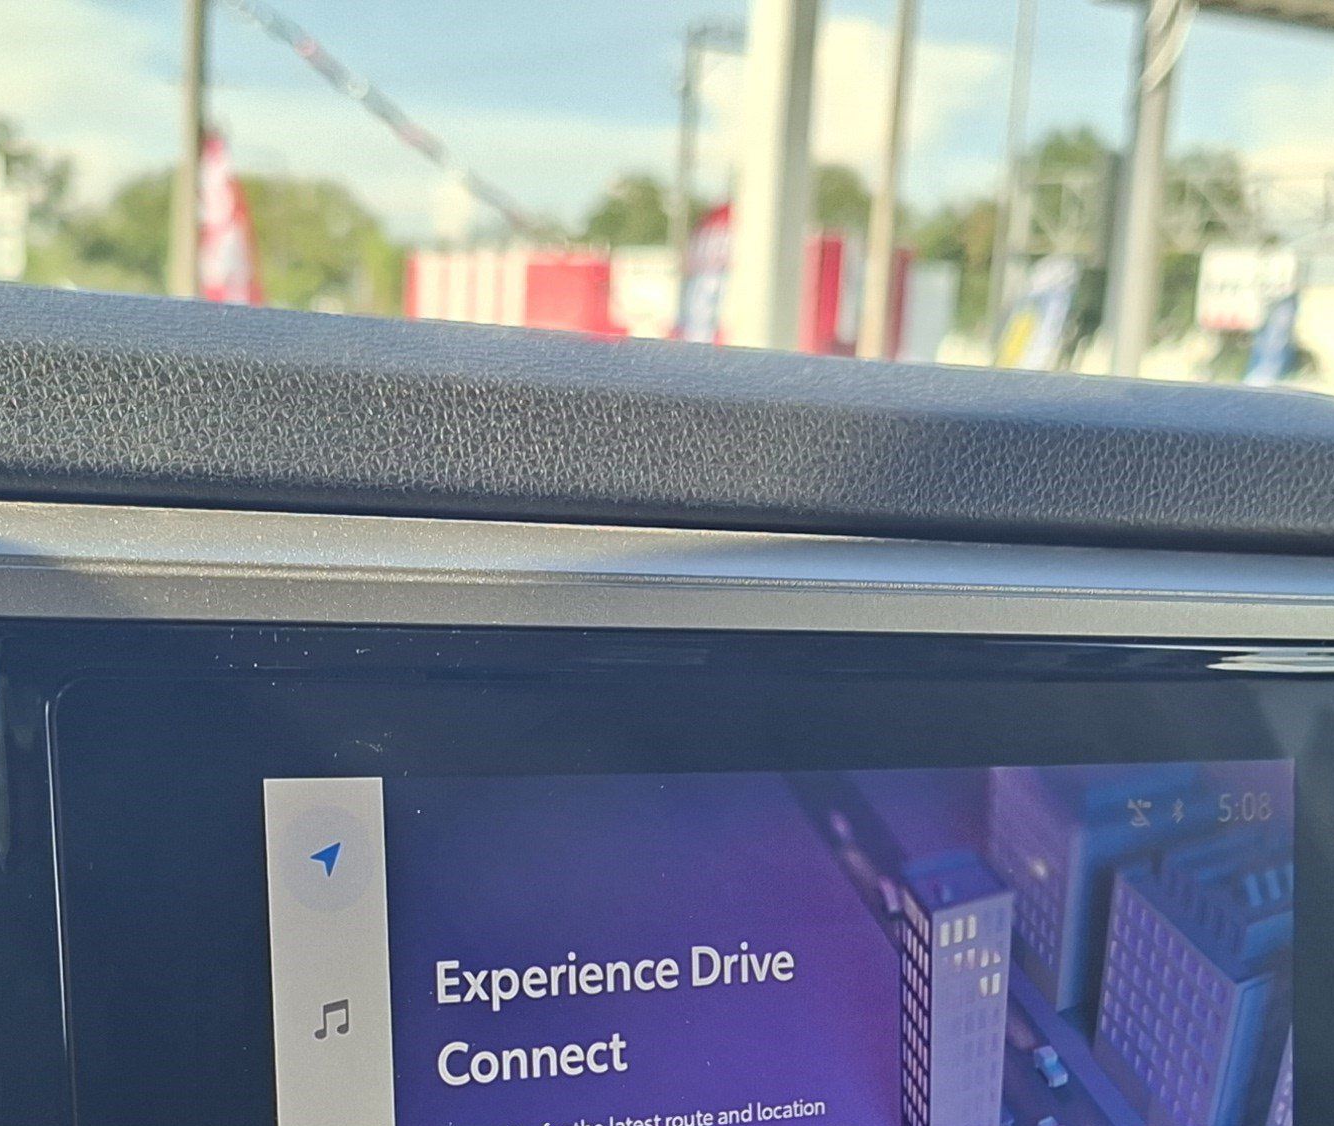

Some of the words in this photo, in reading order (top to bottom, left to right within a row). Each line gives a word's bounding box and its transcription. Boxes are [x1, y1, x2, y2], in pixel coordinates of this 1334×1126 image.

[1219, 792, 1272, 822] 5:08
[436, 951, 679, 1012] Experience
[691, 941, 795, 987] Drive
[437, 1033, 628, 1086] Connect
[717, 1102, 753, 1126] and
[757, 1099, 826, 1122] location
